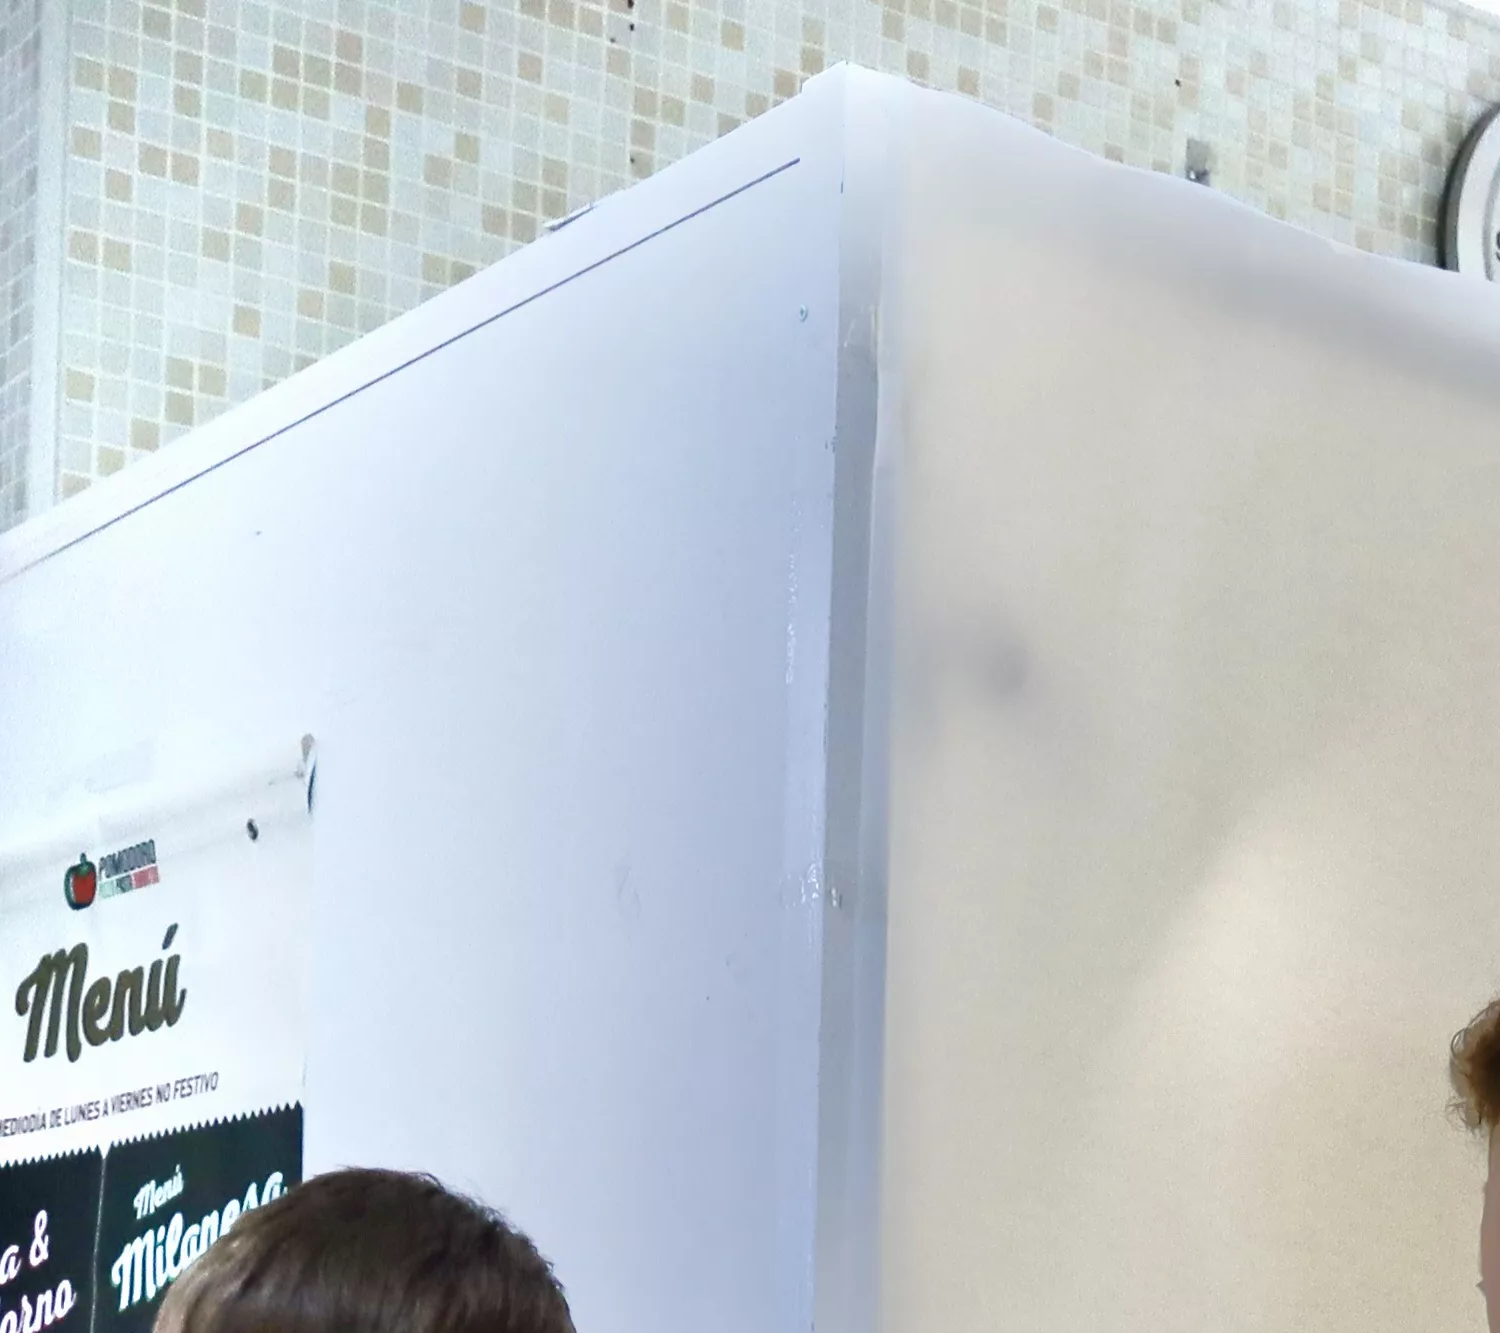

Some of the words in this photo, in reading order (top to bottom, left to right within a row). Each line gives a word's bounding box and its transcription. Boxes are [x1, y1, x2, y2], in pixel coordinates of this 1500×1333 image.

[14, 923, 187, 1063] Menú
[49, 1107, 63, 1129] DE
[64, 1100, 100, 1126] LUNES
[102, 1097, 109, 1117] A
[111, 1086, 153, 1114] VIERNES
[155, 1082, 171, 1104] NO
[173, 1071, 219, 1101] FESTIVO
[133, 1164, 184, 1220] Menú
[29, 1209, 49, 1267] &
